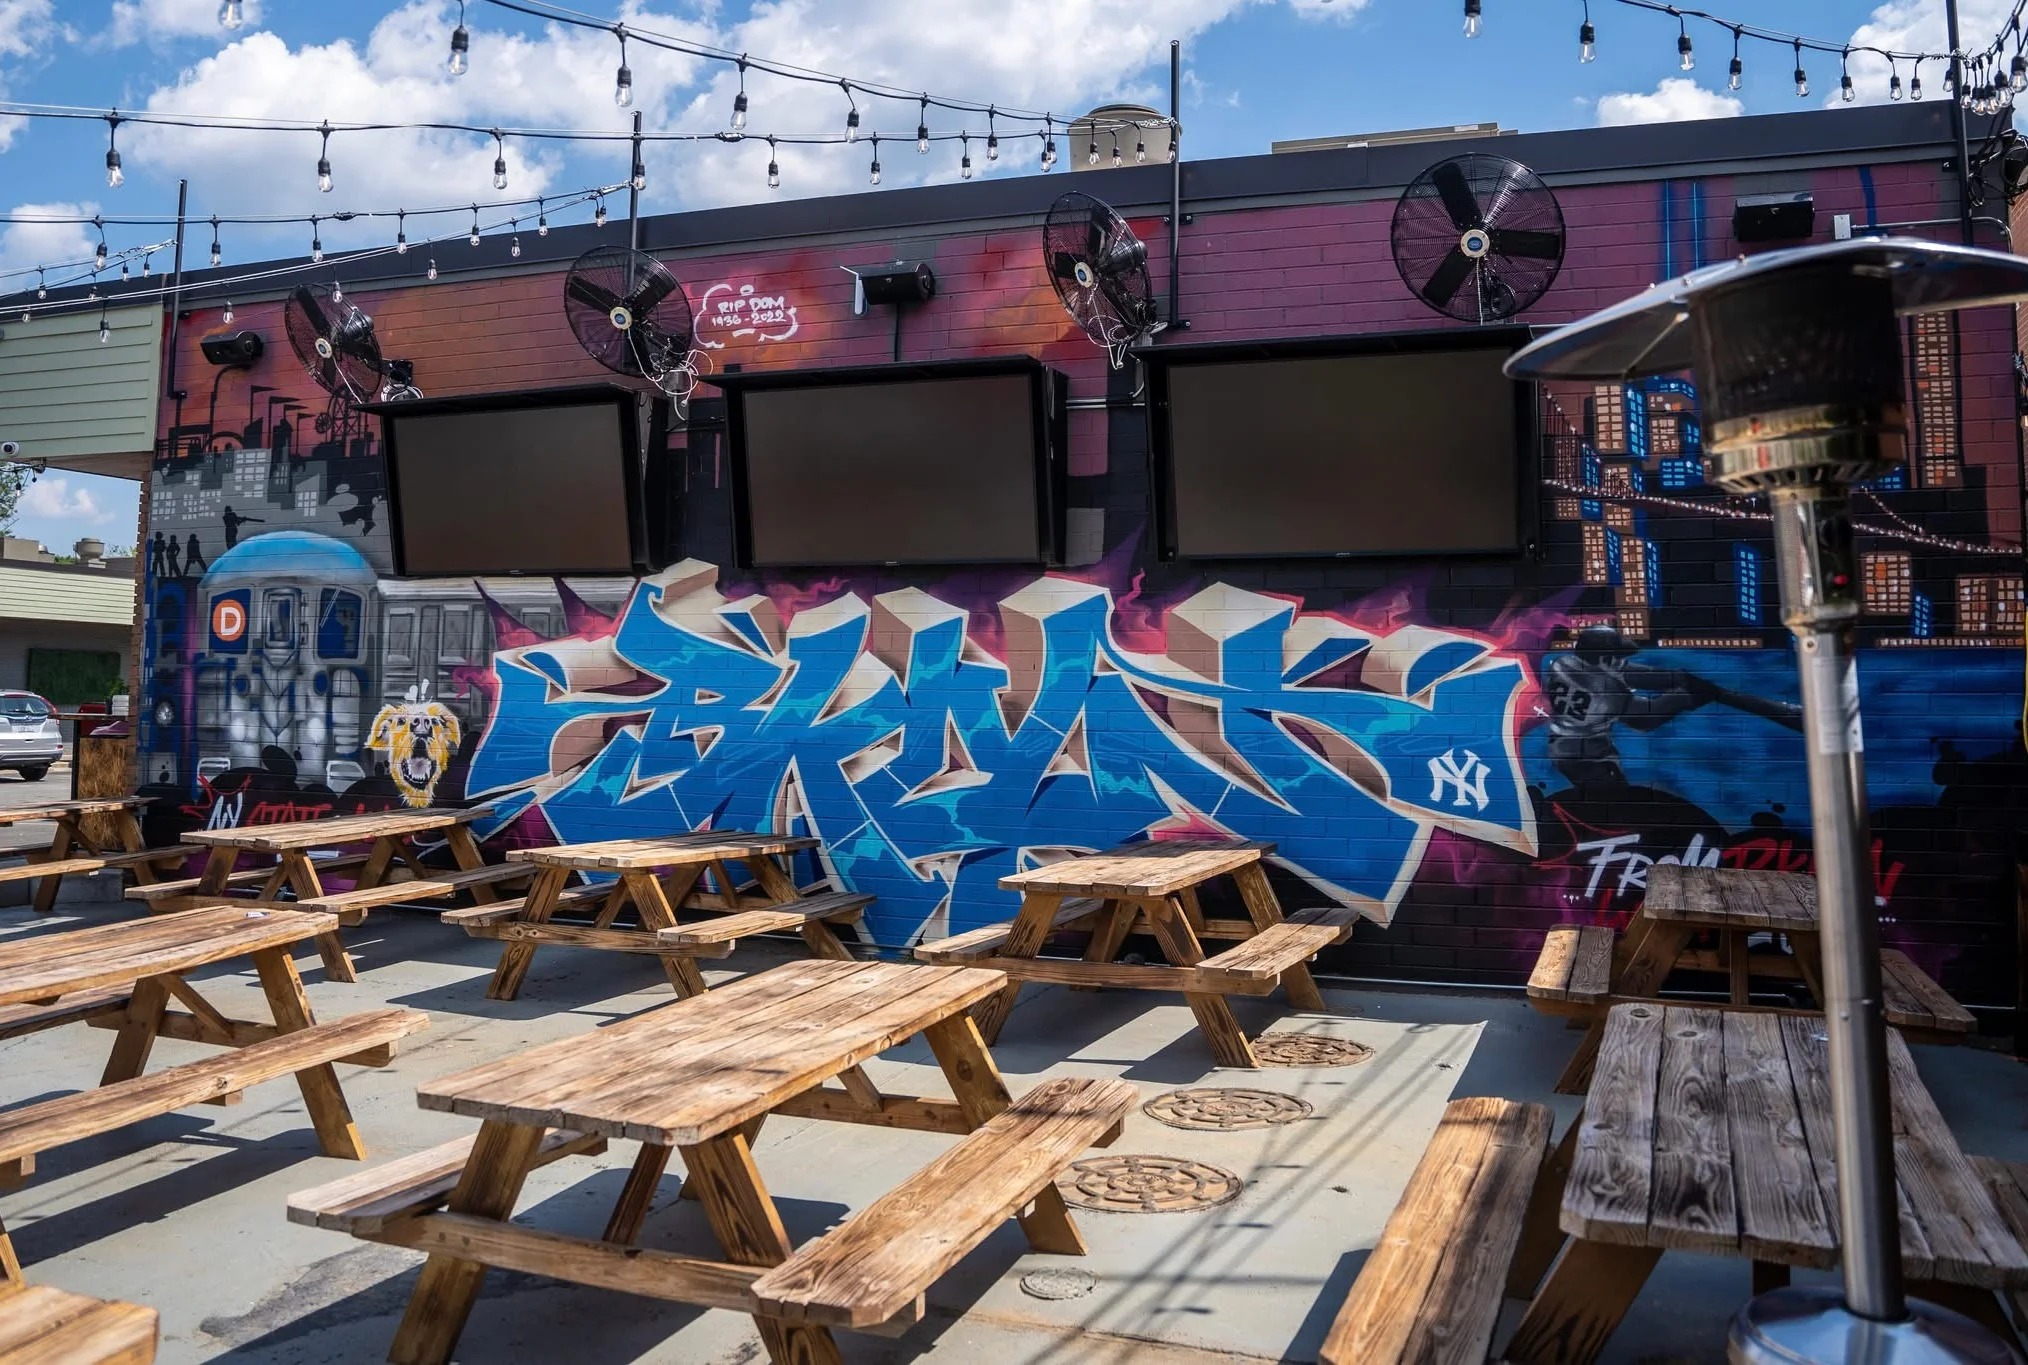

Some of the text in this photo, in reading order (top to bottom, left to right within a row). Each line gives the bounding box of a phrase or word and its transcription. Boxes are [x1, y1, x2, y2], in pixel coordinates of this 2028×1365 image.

[718, 295, 785, 315] RIP DOM
[221, 606, 241, 636] D
[1427, 747, 1492, 812] NY
[1576, 833, 1722, 898] FRM
